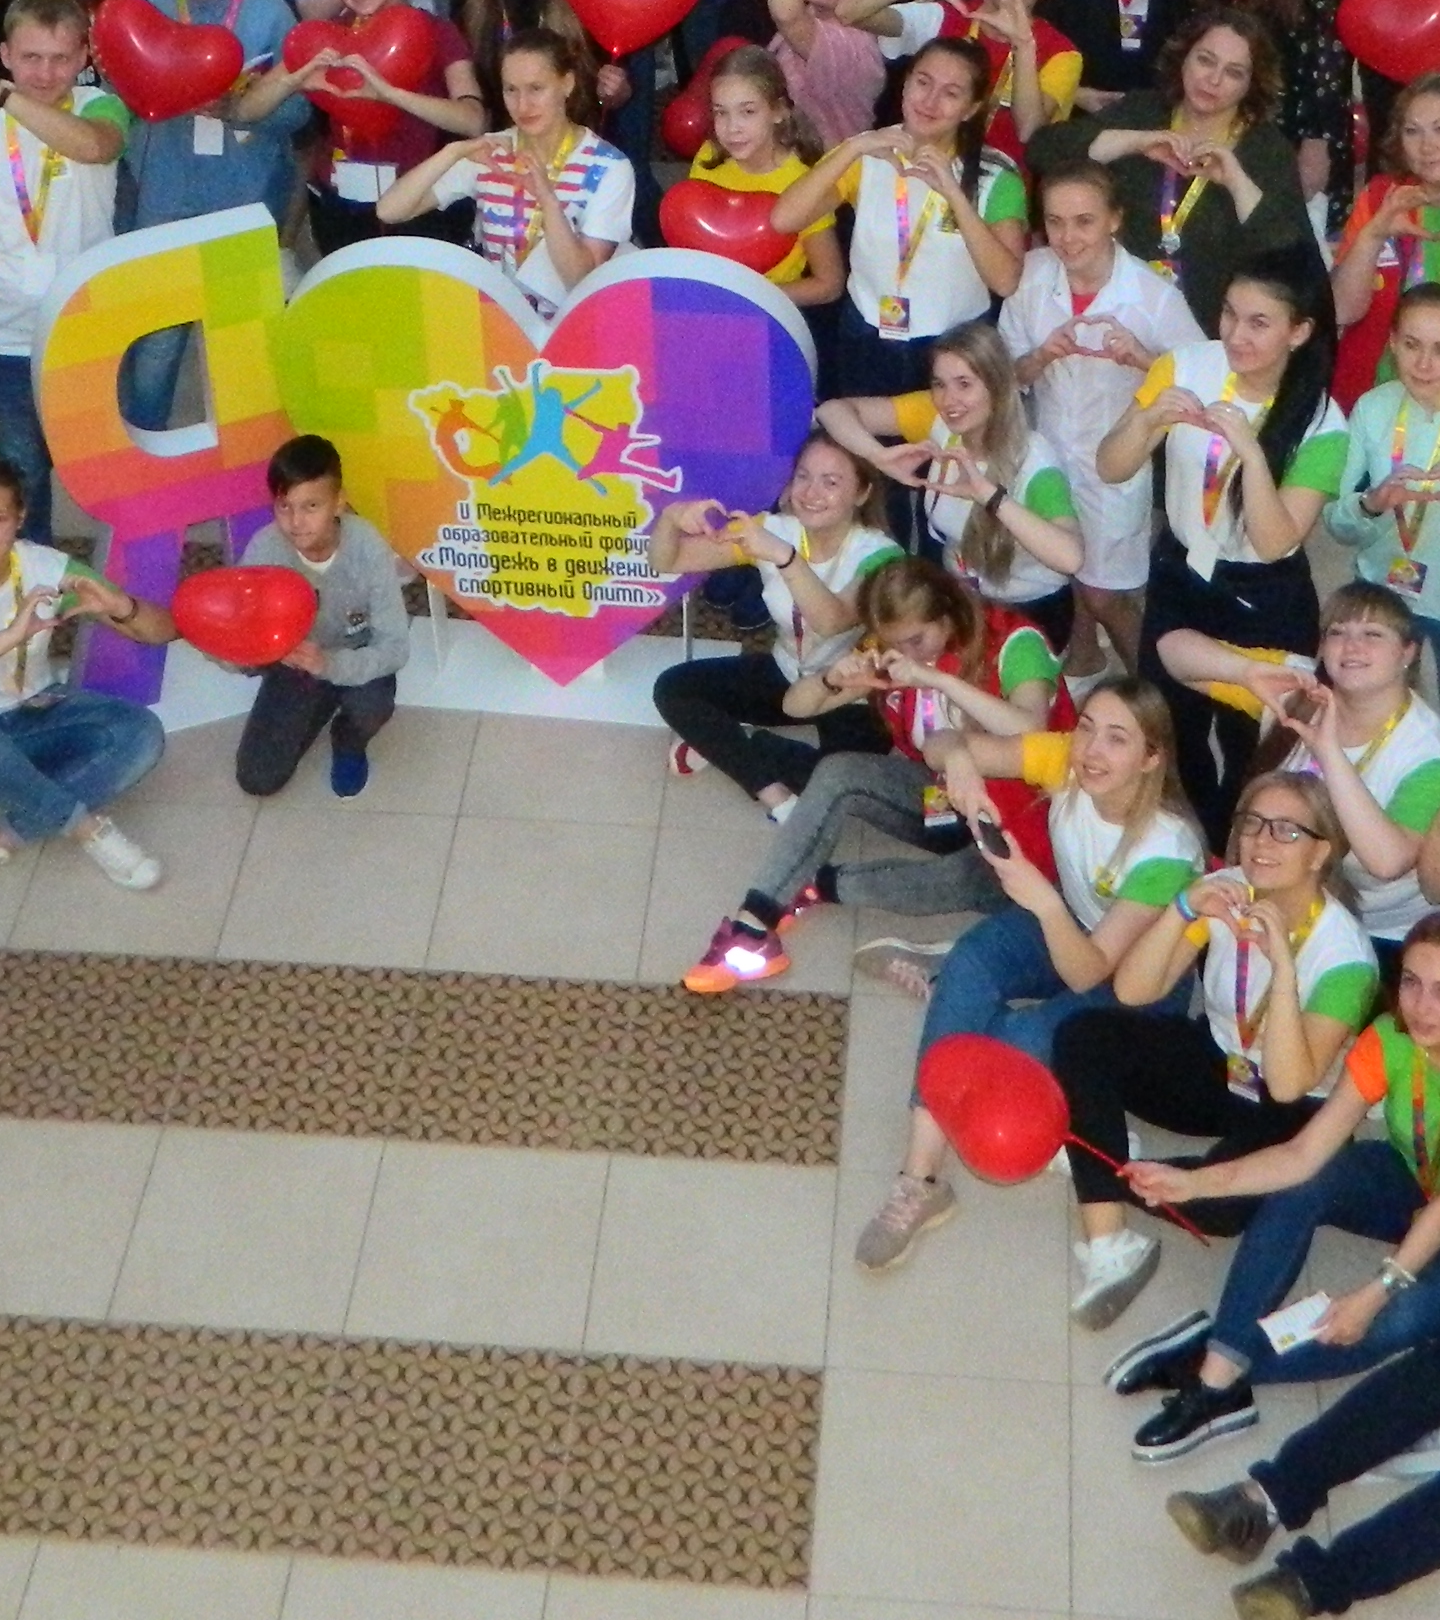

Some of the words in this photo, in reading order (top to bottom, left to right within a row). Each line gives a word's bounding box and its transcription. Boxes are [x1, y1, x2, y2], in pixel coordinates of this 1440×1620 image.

[476, 502, 637, 529] Межрегиональный
[442, 527, 593, 549] образовательный
[547, 557, 558, 572] в
[459, 577, 575, 600] спортивный
